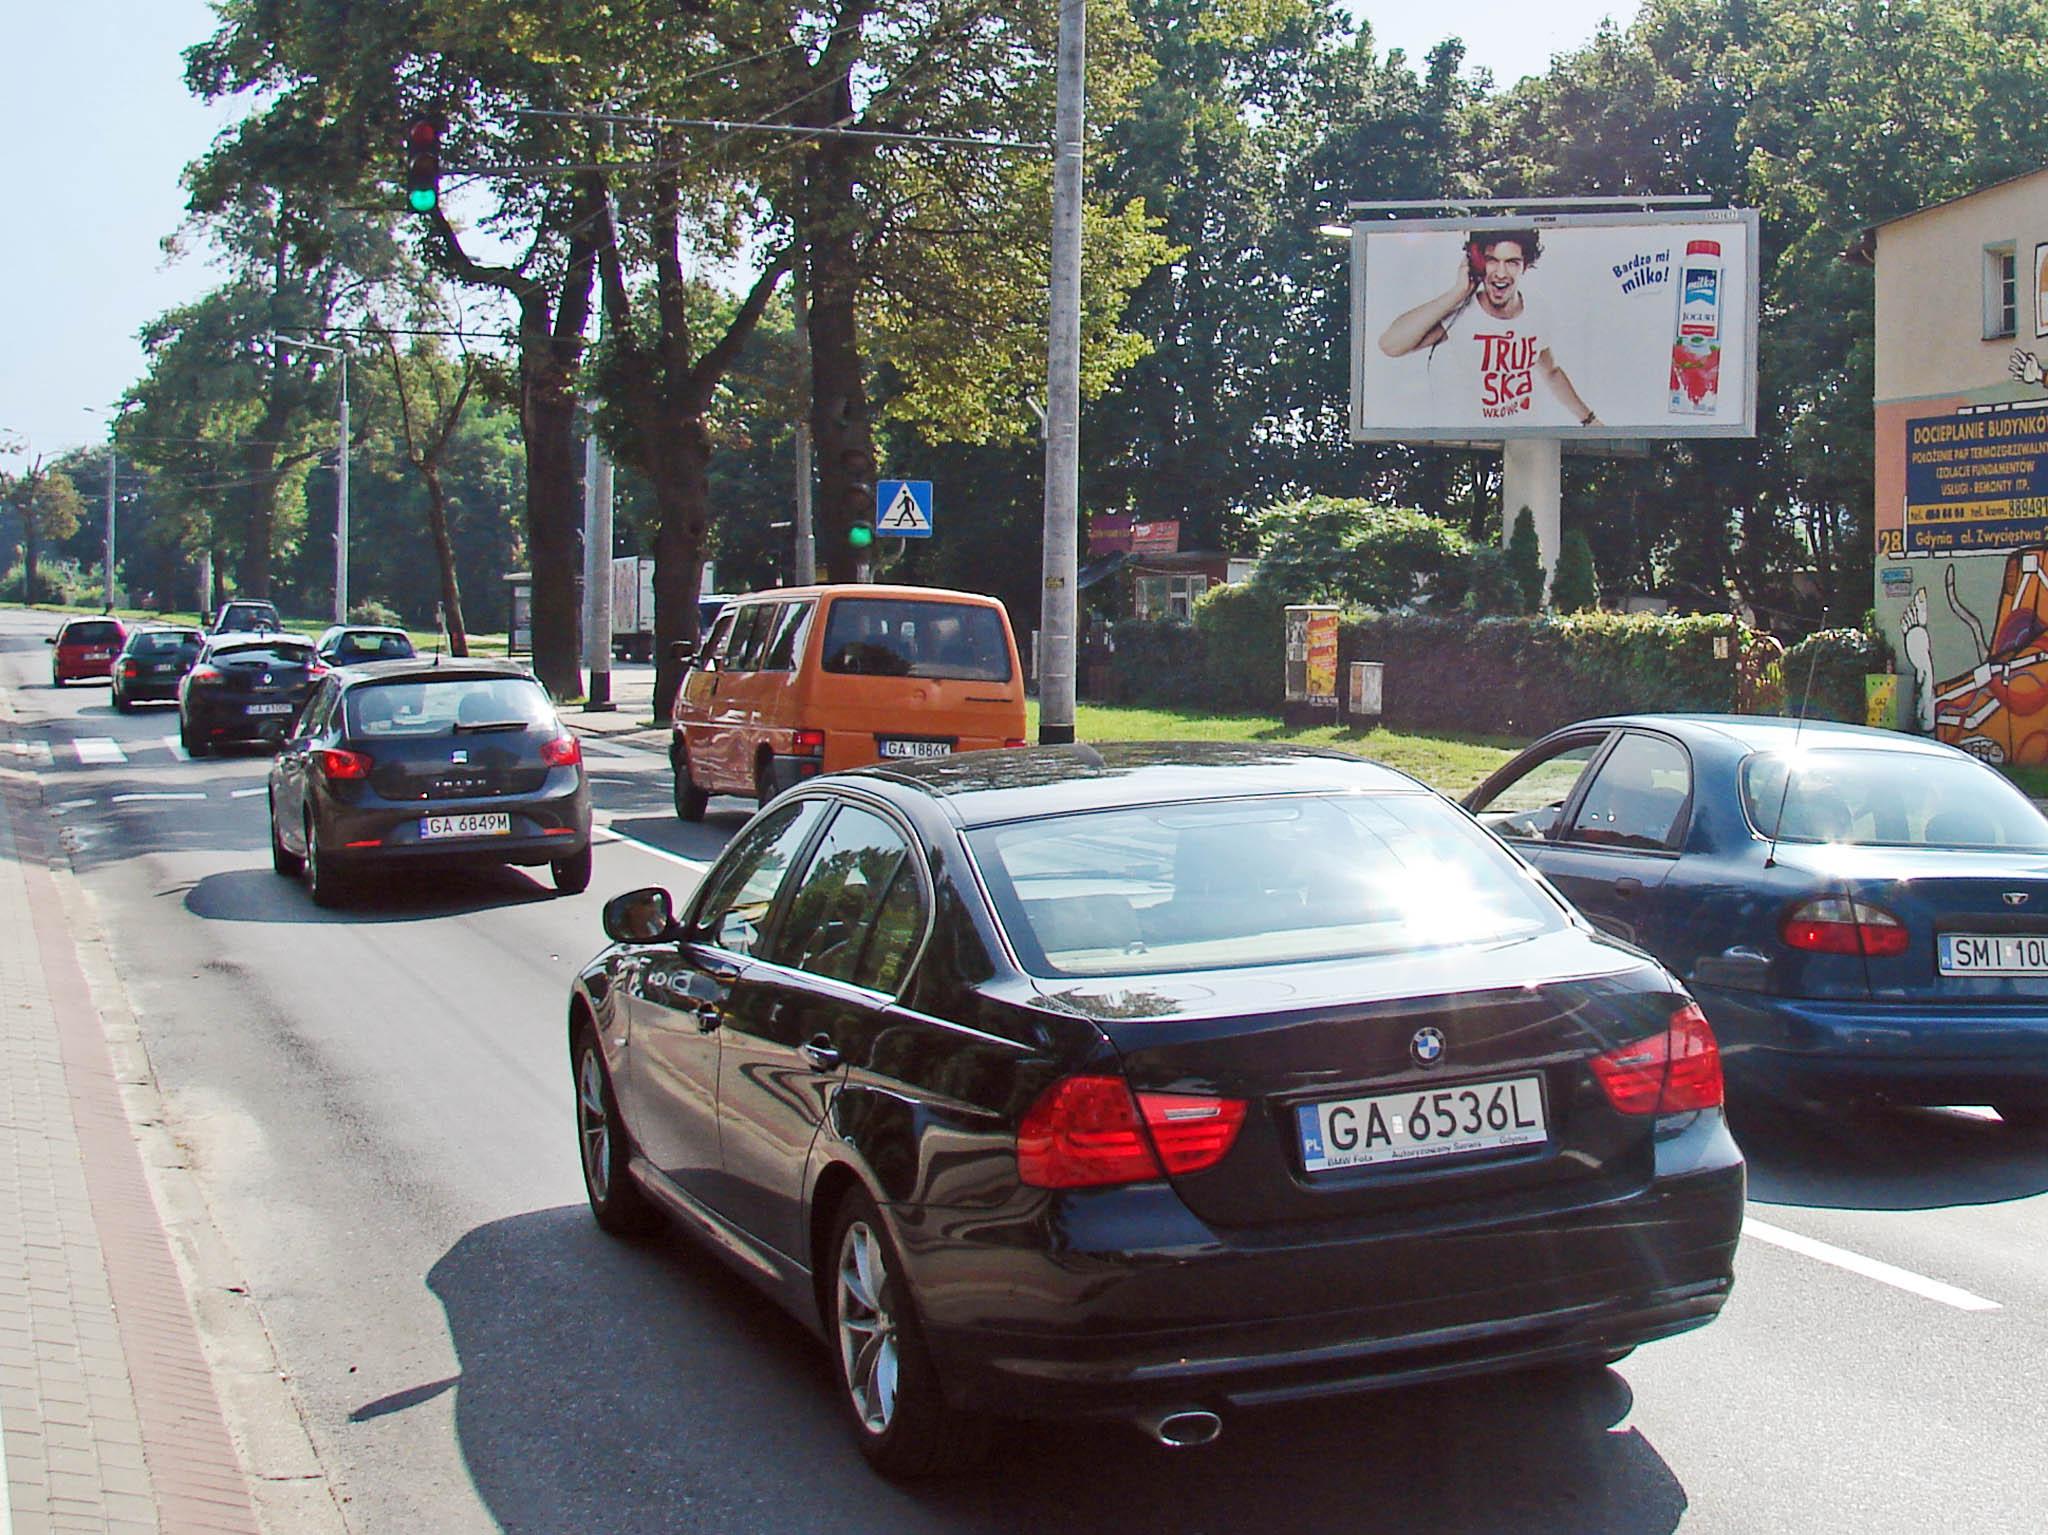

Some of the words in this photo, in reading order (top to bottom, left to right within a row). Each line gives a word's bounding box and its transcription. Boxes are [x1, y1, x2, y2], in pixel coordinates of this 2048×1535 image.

[1612, 253, 1652, 279] Bardzo
[1655, 249, 1670, 263] mi
[1621, 266, 1670, 295] milko!
[1473, 330, 1537, 373] TRUE
[1913, 421, 1984, 444] DOCIEPLANIE
[1941, 483, 1969, 496] USŁUGI
[1974, 480, 2012, 494] REMONTY
[1880, 531, 1901, 556] 28
[1915, 530, 1953, 548] Gdynia
[1961, 528, 1974, 544] al.
[1976, 526, 2042, 547] Zwycięstwa
[888, 743, 906, 755] GA
[912, 743, 948, 757] 1886K
[430, 817, 453, 833] GA
[459, 815, 507, 831] 6849M
[1956, 939, 2001, 967] SMI
[1328, 1102, 1392, 1150] GA
[1408, 1085, 1536, 1141] 6536L
[1305, 1139, 1322, 1152] PL
